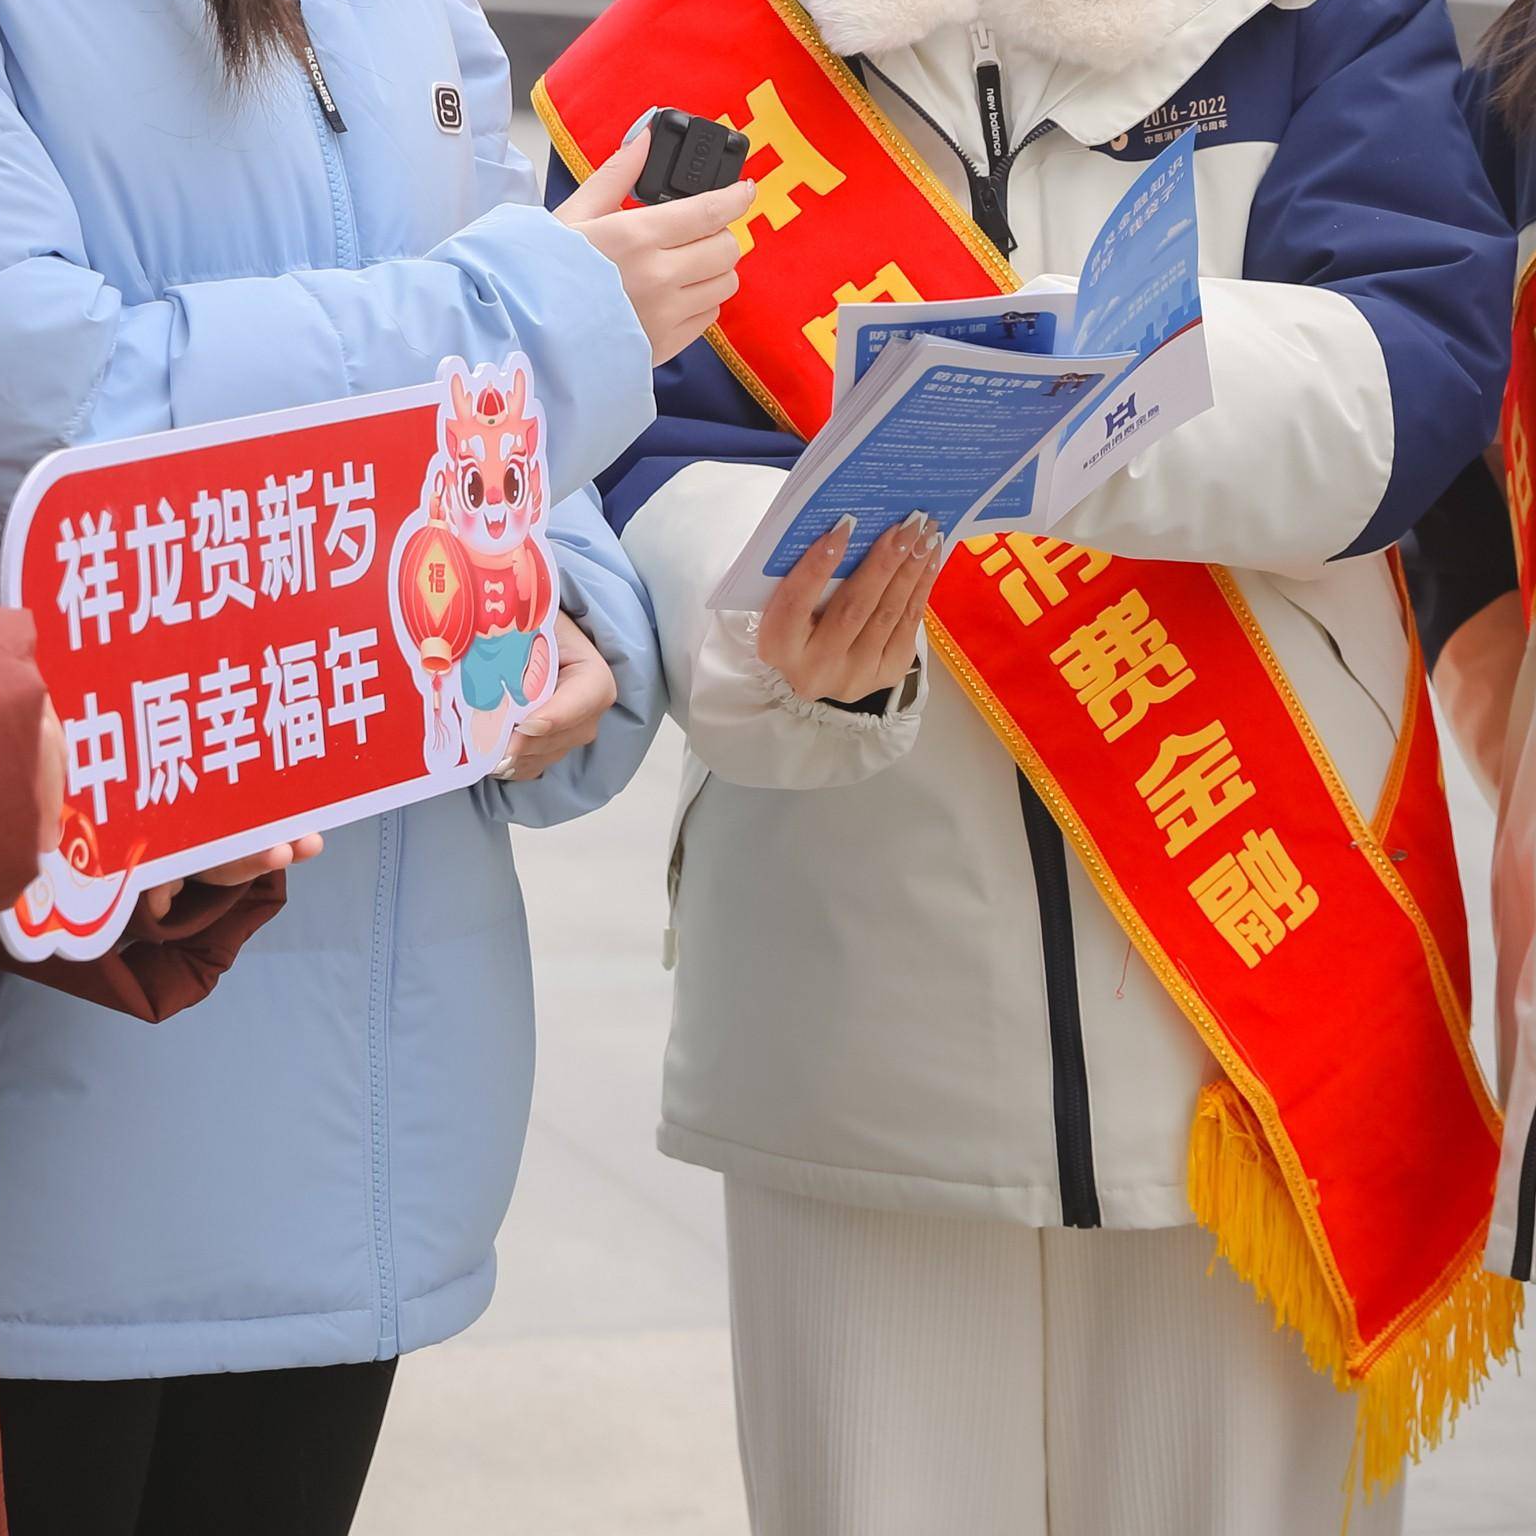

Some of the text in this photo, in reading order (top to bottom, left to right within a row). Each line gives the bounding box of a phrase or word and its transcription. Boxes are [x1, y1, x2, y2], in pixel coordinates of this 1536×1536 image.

[304, 47, 335, 112] SKECHERS
[986, 87, 1002, 156] new balance
[931, 370, 1043, 390] 防范电信诈骗
[56, 462, 378, 652] 祥龙贺新岁
[428, 562, 446, 593] 福
[65, 626, 386, 826] 中原幸福年
